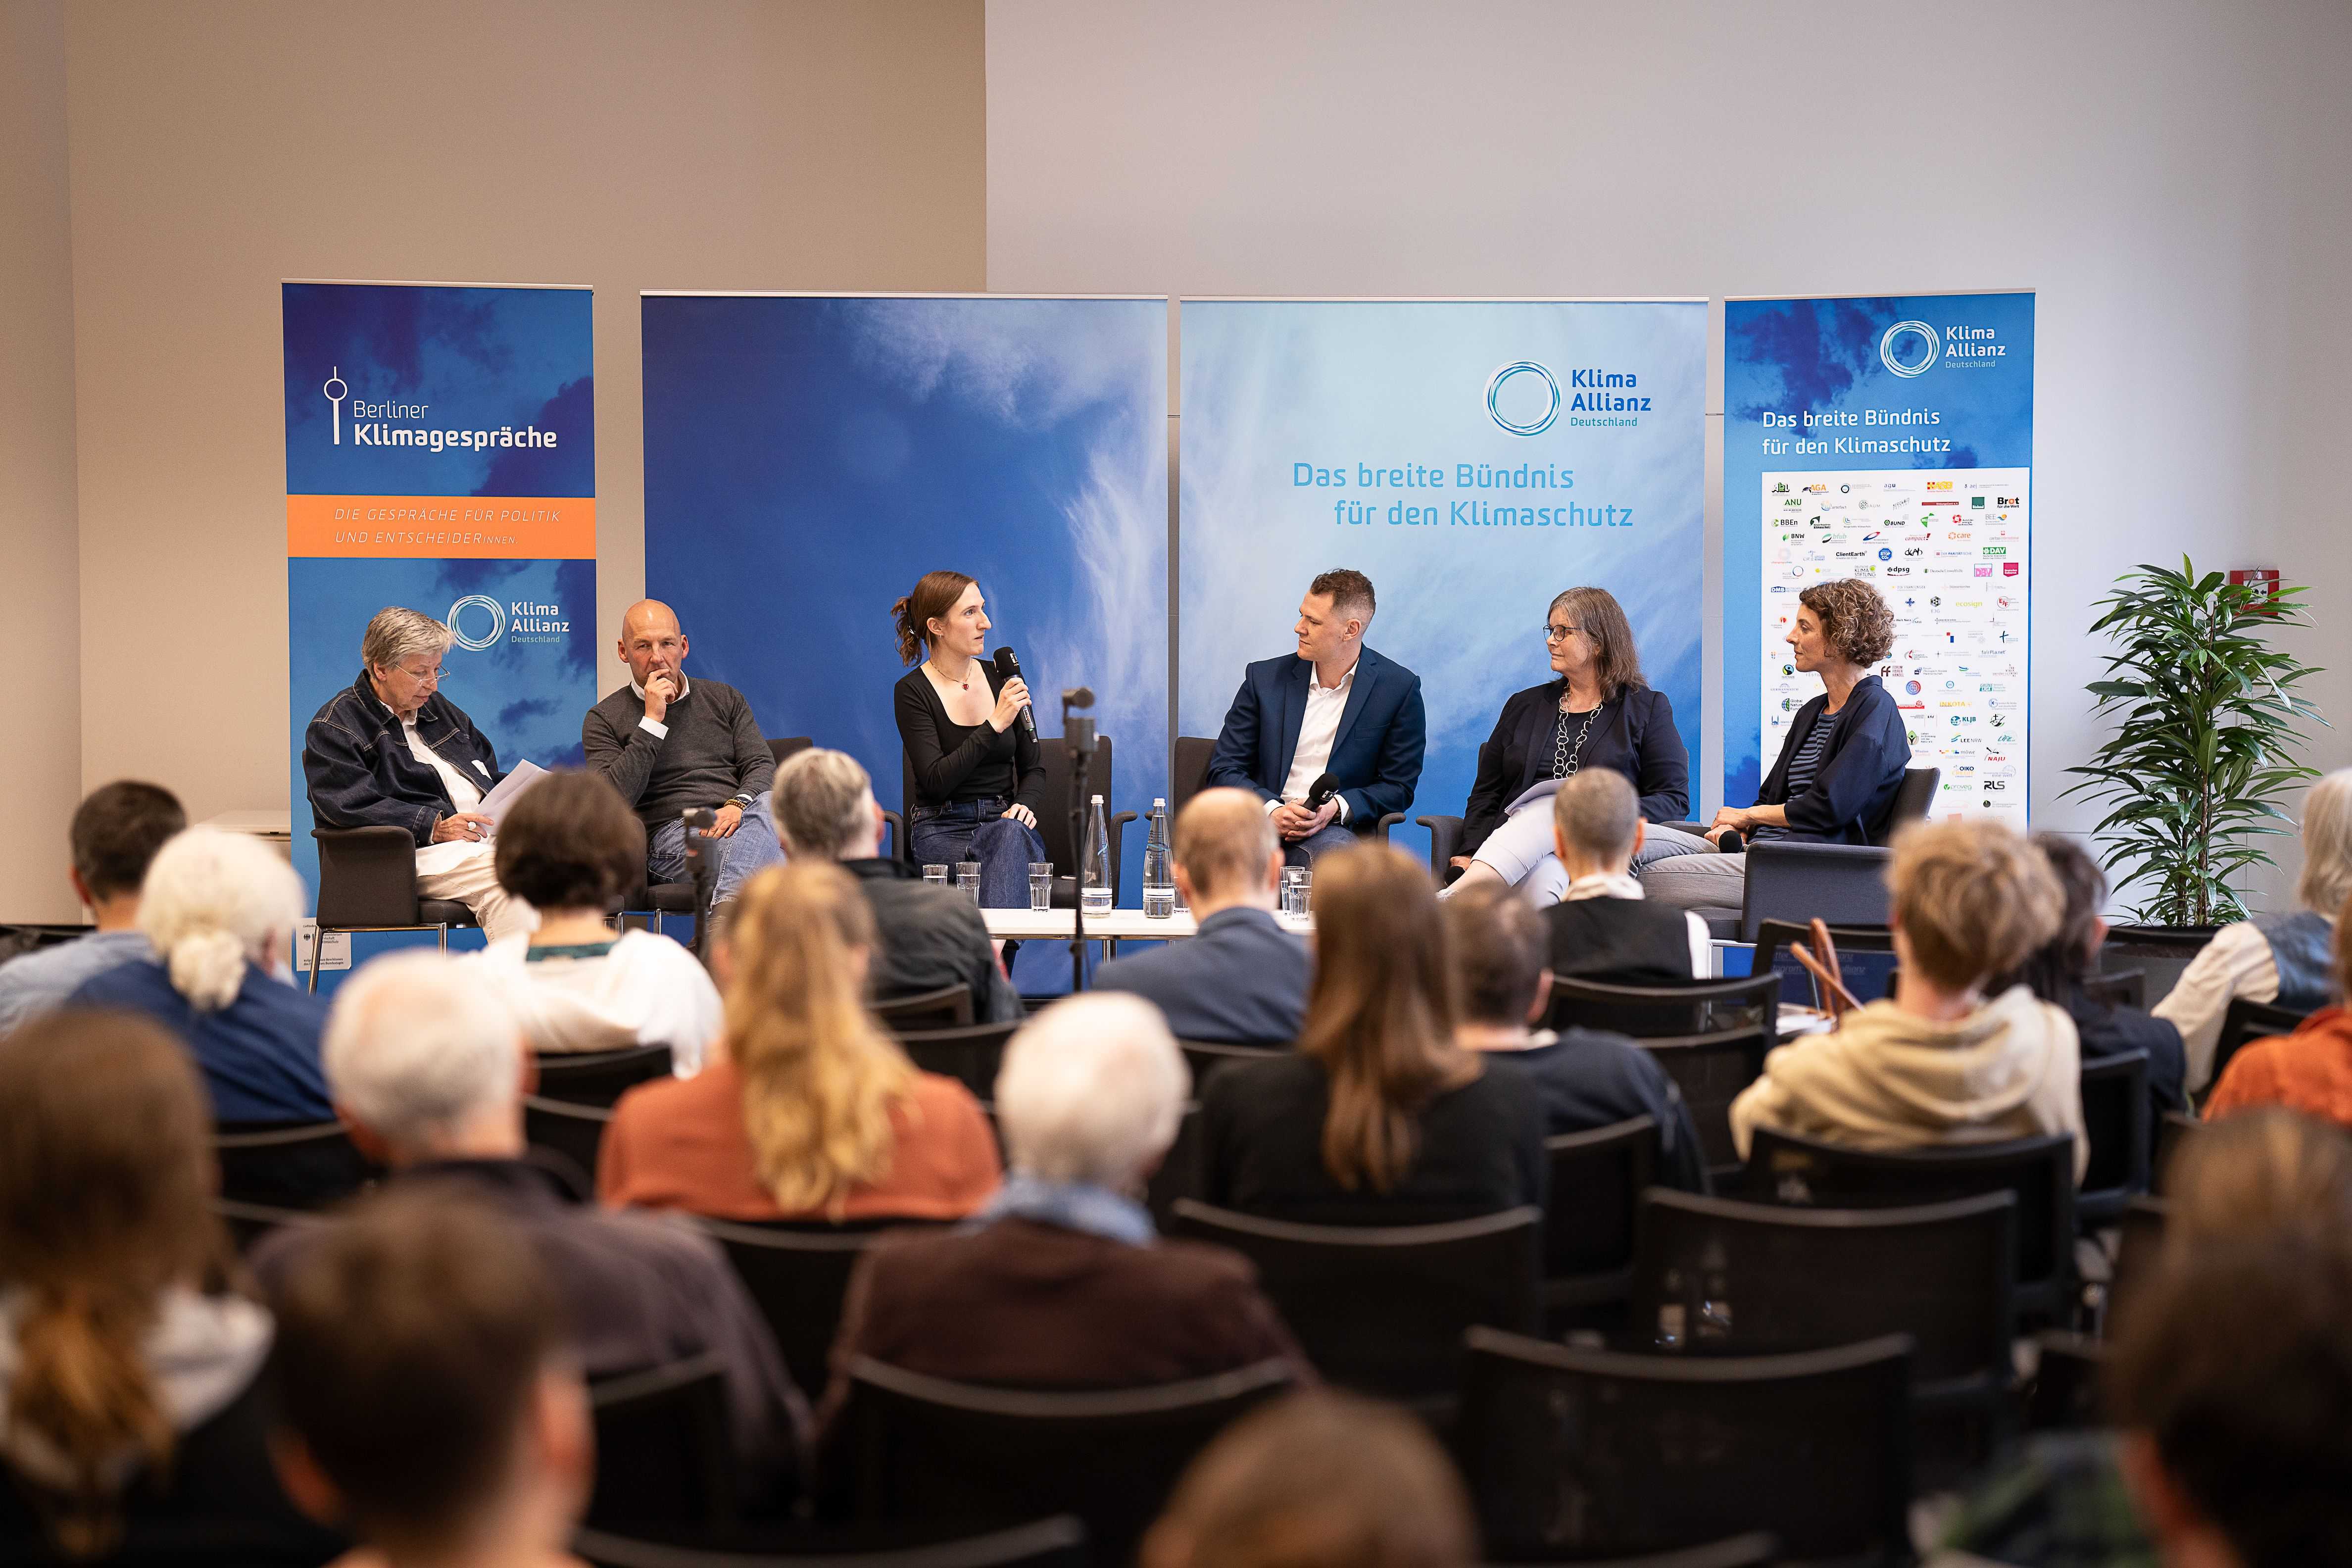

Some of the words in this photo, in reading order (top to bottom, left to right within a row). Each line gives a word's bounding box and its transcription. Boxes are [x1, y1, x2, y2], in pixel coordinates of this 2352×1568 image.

[1946, 326, 1995, 341] Klima
[1945, 343, 2006, 357] Allianz
[1946, 360, 1996, 368] Deutschland
[1572, 369, 1636, 388] Klima
[1570, 392, 1651, 411] Allianz
[353, 400, 429, 419] Berliner
[1570, 417, 1637, 426] Deutschland
[1763, 411, 1797, 428] Das
[1803, 410, 1858, 427] breite
[1865, 408, 1940, 426] Bündnis
[354, 423, 557, 452] Klimagespräche
[1762, 439, 1789, 455] für
[1795, 438, 1828, 454] den
[1835, 436, 1951, 454] Klimaschutz
[1294, 463, 1346, 487] Das
[1359, 462, 1444, 488] breite
[1457, 463, 1573, 489] Bündnis
[335, 508, 360, 520] DIE
[367, 507, 458, 521] GESPRÄCHE
[464, 508, 493, 521] FÜR
[500, 510, 561, 522] POLITIK
[1334, 500, 1376, 525] für
[1388, 500, 1438, 526] den
[1451, 501, 1633, 527] Klimaschutz
[336, 531, 368, 543] UND
[511, 601, 559, 615] Klima
[1956, 600, 1982, 608] ecosign
[511, 618, 570, 632] Allianz
[1984, 781, 2005, 789] RLS
